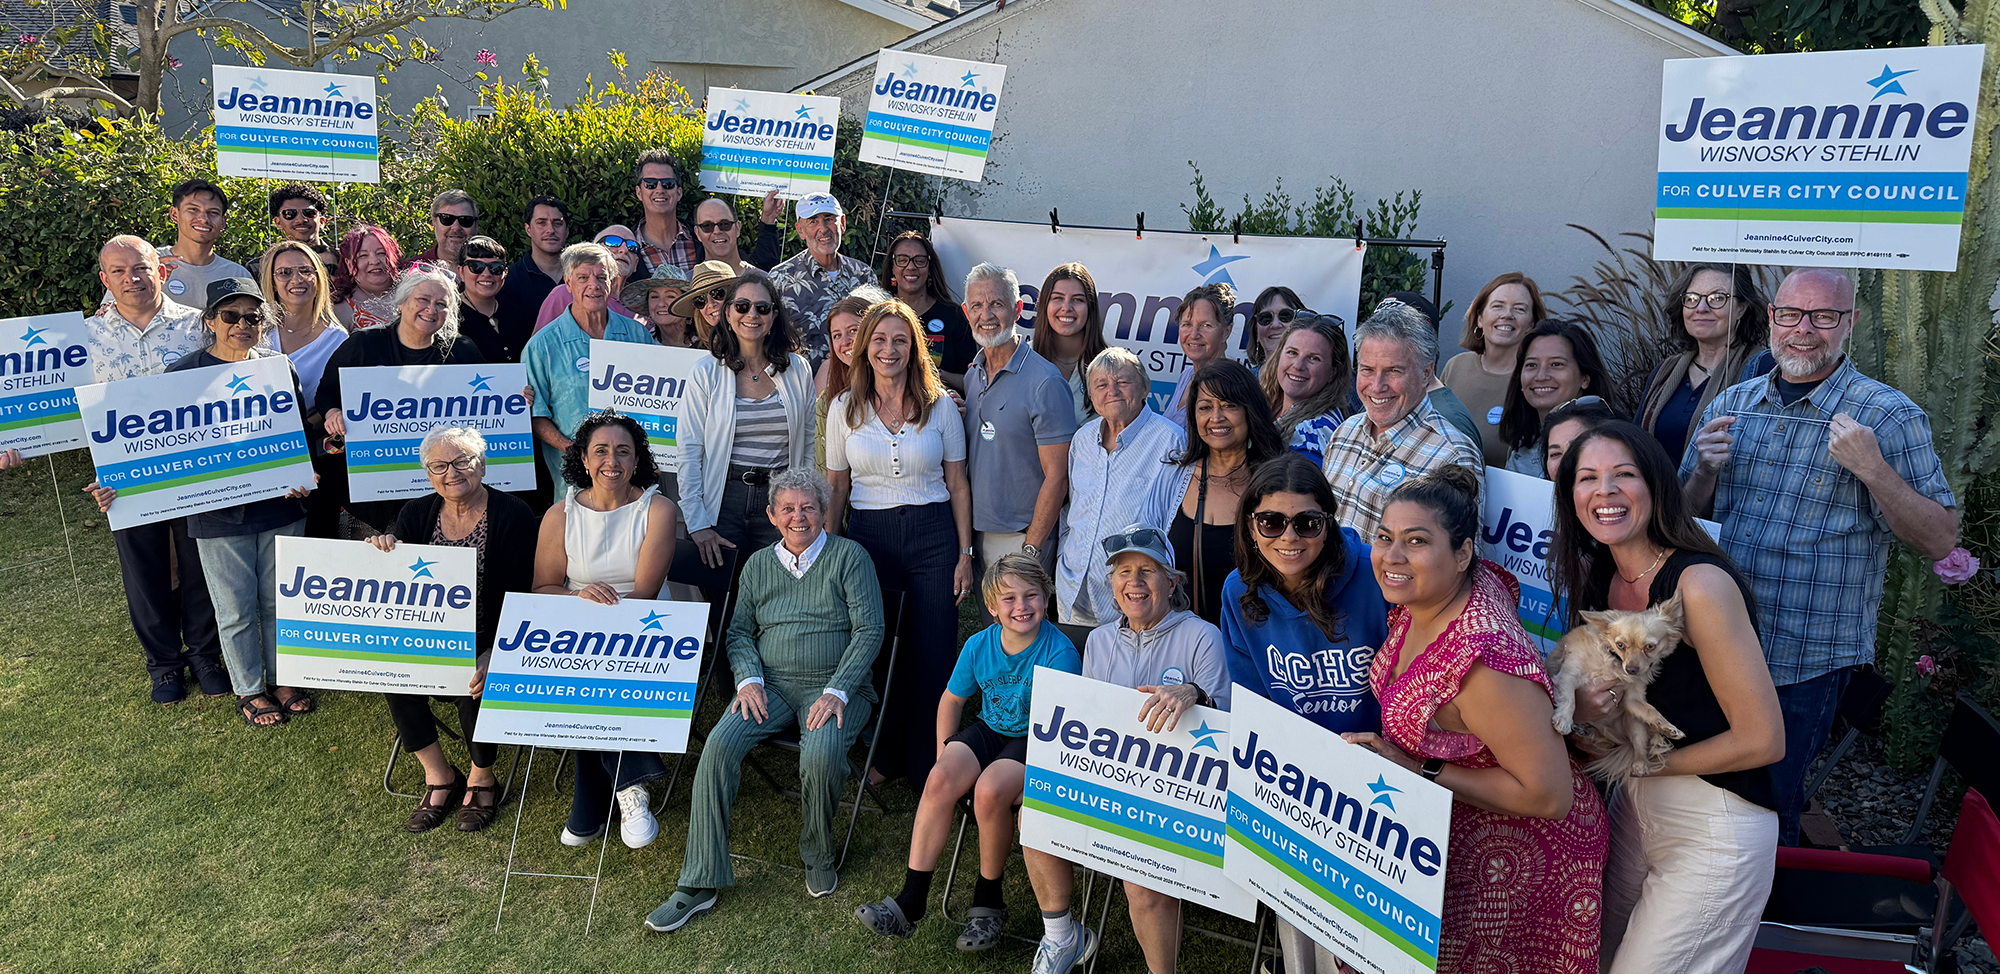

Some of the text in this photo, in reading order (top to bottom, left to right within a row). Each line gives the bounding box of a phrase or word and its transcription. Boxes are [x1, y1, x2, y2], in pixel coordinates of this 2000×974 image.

[217, 86, 373, 119] Jeannine
[874, 72, 996, 112] Jeannine
[240, 113, 353, 129] WISNOSKY STEHLIN
[707, 109, 833, 141] Jeannine
[888, 100, 976, 122] WISNOSKY STEHLIN
[1665, 98, 1968, 141] Jeannine
[240, 133, 287, 143] CULVER
[291, 137, 318, 145] CITY
[322, 139, 375, 148] COUNCIL
[722, 134, 815, 150] WISNOSKY STEHLIN
[883, 121, 918, 133] CULVER
[921, 127, 943, 137] CITY
[945, 131, 986, 145] COUNCIL
[720, 153, 757, 163] CULVER
[760, 157, 783, 165] CITY
[785, 159, 829, 170] COUNCIL
[1701, 144, 1920, 162] WISNOSKY STEHLIN
[1663, 184, 1958, 200] FOR CULVER CITY COUNCIL
[1744, 234, 1853, 244] Jeannine4CulverCity.com
[0, 345, 87, 376] nine
[4, 372, 65, 390] STEHLIN
[592, 365, 686, 398] Jean
[0, 404, 23, 415] ITY
[91, 390, 293, 443] Jeannine
[346, 392, 526, 421] Jeannine
[613, 395, 678, 410] WISNOSKY
[124, 418, 271, 453] WISNOSKY STEHLIN
[374, 447, 420, 458] CULVE
[486, 441, 530, 451] UNCIL
[103, 440, 304, 482] FOR CULVER CITY COUNCIL
[279, 566, 471, 609] Jeannine
[305, 602, 445, 622] WISNOSKY STEHLIN
[280, 629, 470, 651] FOR CULVER CITY COUNCIL
[498, 620, 699, 660] Jeannine
[521, 656, 669, 674] WISNOSKY STEHLIN
[1267, 644, 1374, 690] CCHS
[488, 683, 690, 701] FOR CULVER CITY COUNCIL
[1292, 692, 1362, 714] Senior
[544, 722, 621, 731] Jeannine4CulverCity.com
[1033, 705, 1228, 792] Jeannin
[1060, 751, 1226, 812] WISNOSKY STEHLIN
[1029, 778, 1224, 848] FOR CULVER CITY COUN
[1232, 731, 1441, 876] Jeannine
[1255, 782, 1406, 884] WISNOSKY STEHLIN
[1092, 841, 1176, 873] Jeannine4CulverCity.com
[1230, 806, 1434, 945] FOR CULVER CITY COUNCIL
[1282, 888, 1358, 943] Jeannine4CulverCity.com
